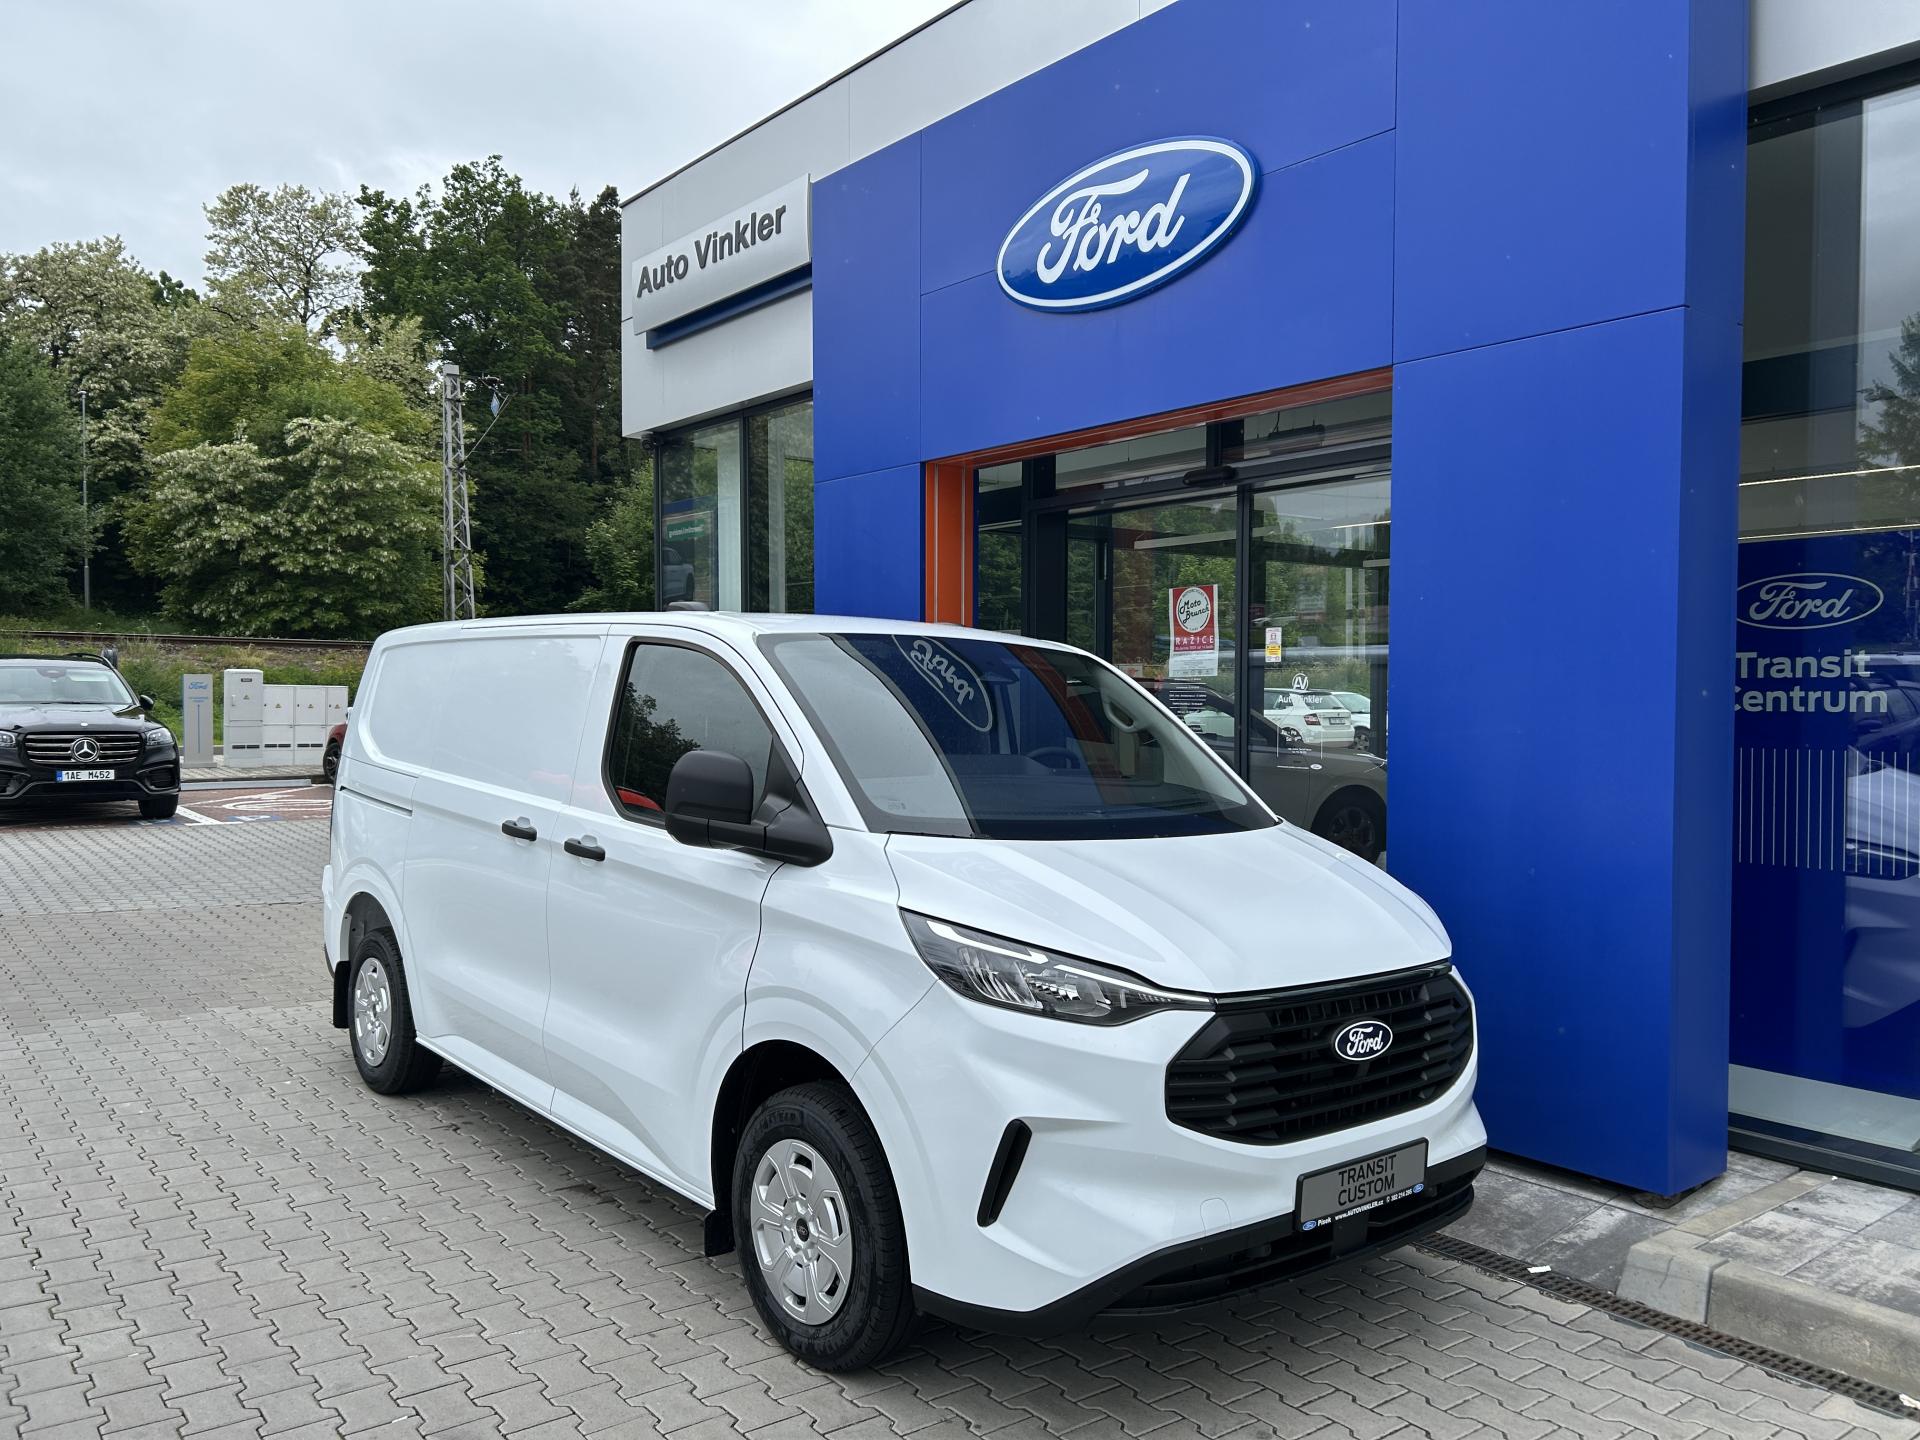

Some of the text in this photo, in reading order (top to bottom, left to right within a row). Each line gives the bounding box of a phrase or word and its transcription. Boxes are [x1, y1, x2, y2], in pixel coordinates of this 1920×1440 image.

[1036, 168, 1191, 284] Ford
[636, 204, 787, 298] Auto Vinkler
[1180, 599, 1202, 615] Moto
[1183, 604, 1210, 624] Brunch
[1749, 581, 1854, 621] Ford
[1175, 634, 1215, 645] RAŽICE
[1735, 649, 1871, 679] Transit
[1278, 694, 1296, 704] Aut
[65, 770, 111, 780] 1AE M452
[1346, 1026, 1384, 1056] Ford
[1338, 1154, 1397, 1187] TRANSIT
[1338, 1173, 1395, 1206] CUSTOM
